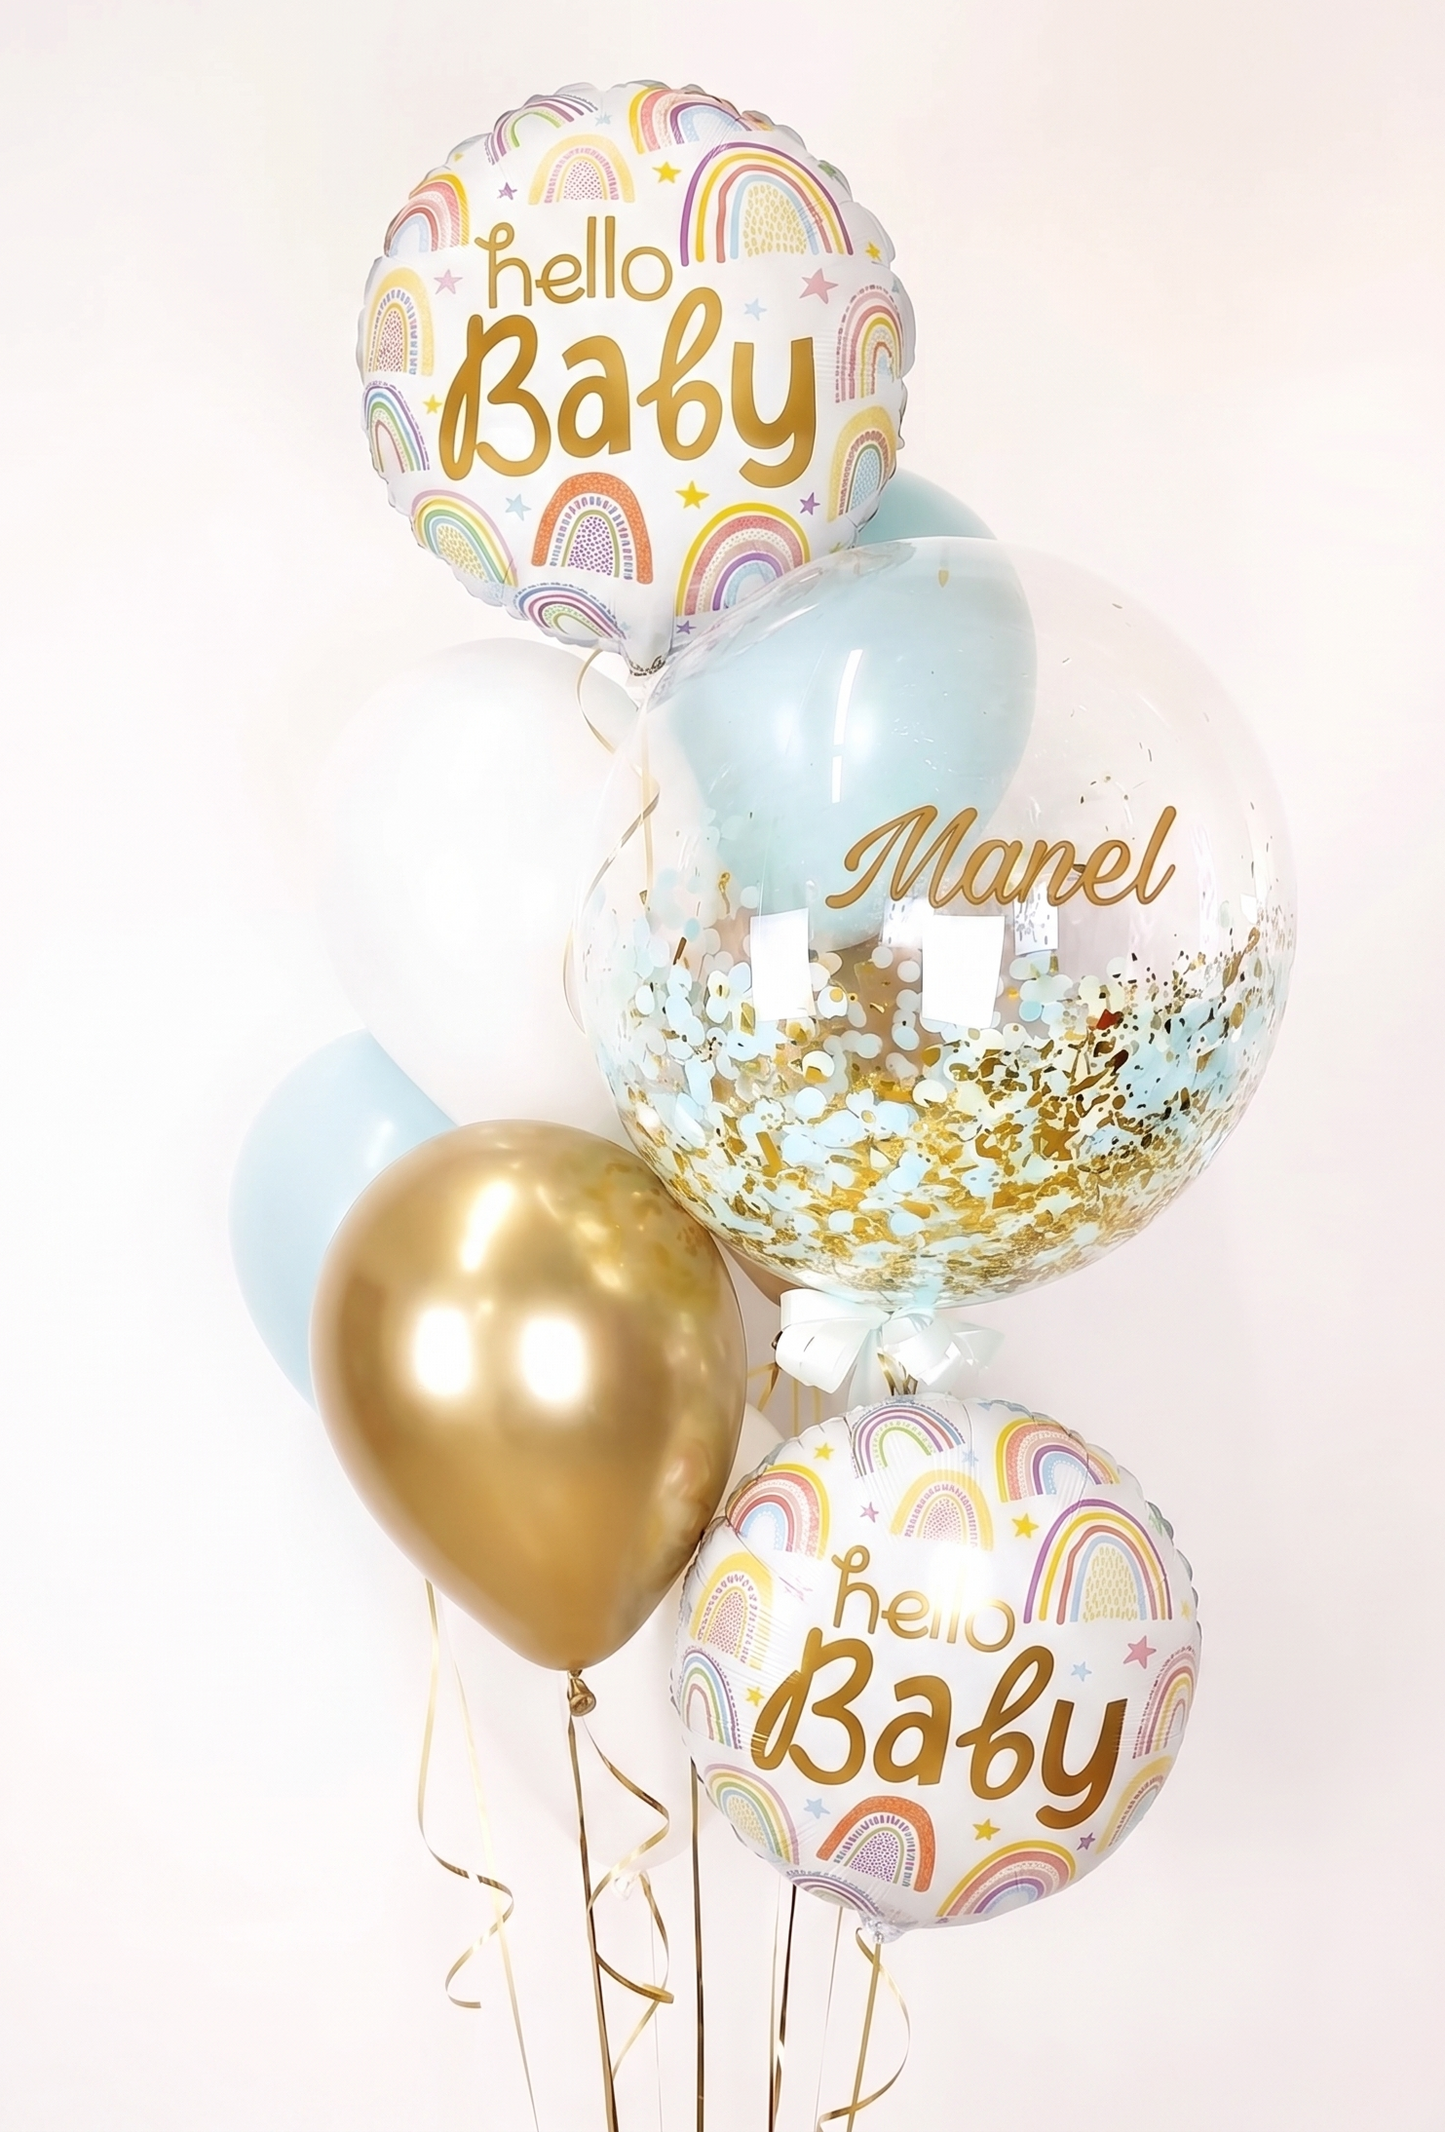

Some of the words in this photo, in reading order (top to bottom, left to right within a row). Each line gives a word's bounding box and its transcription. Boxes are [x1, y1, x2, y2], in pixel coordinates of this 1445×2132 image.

[475, 216, 673, 308] hello
[439, 287, 816, 488] Baby
[825, 805, 1177, 909] Manel
[751, 1627, 1128, 1830] Baby
